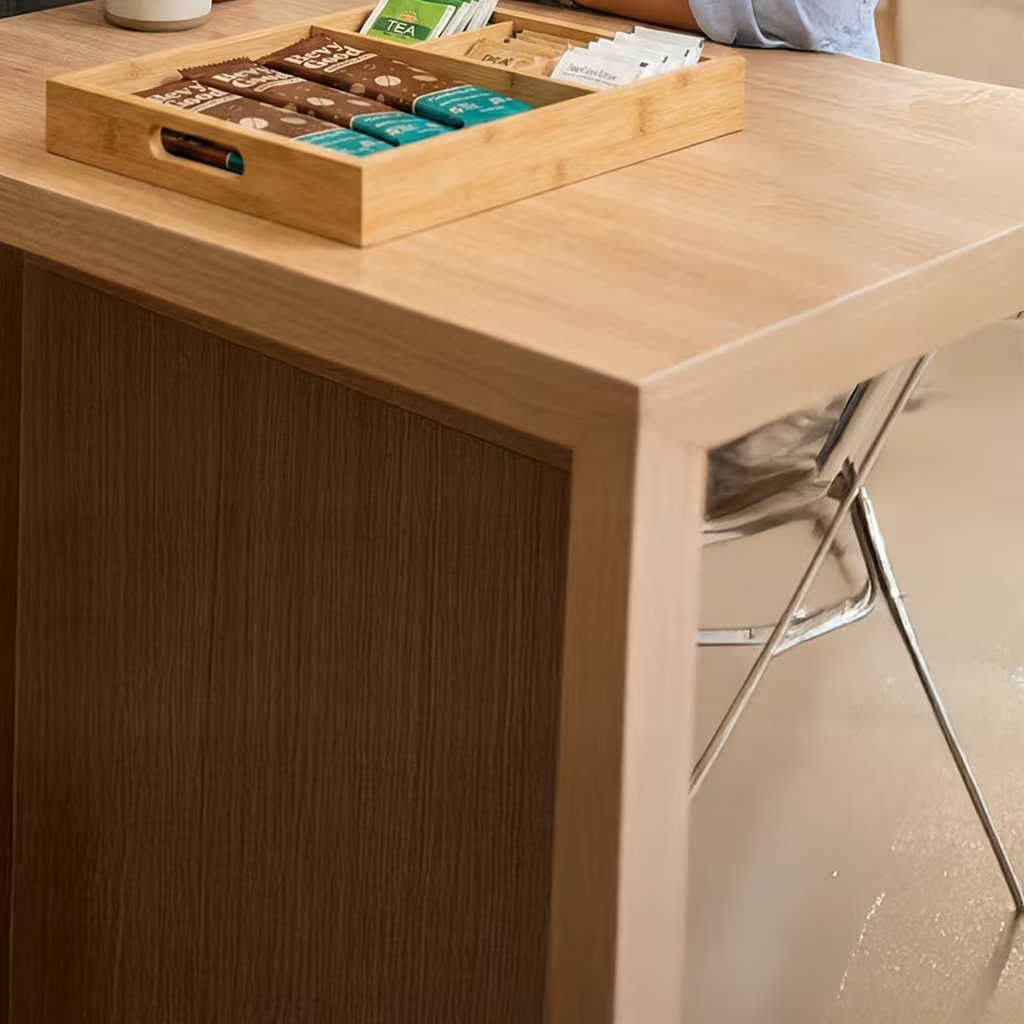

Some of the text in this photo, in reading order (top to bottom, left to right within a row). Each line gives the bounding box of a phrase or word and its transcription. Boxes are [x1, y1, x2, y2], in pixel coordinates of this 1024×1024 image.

[386, 19, 416, 36] TEA
[283, 39, 342, 65] Bevy
[304, 45, 365, 69] Good
